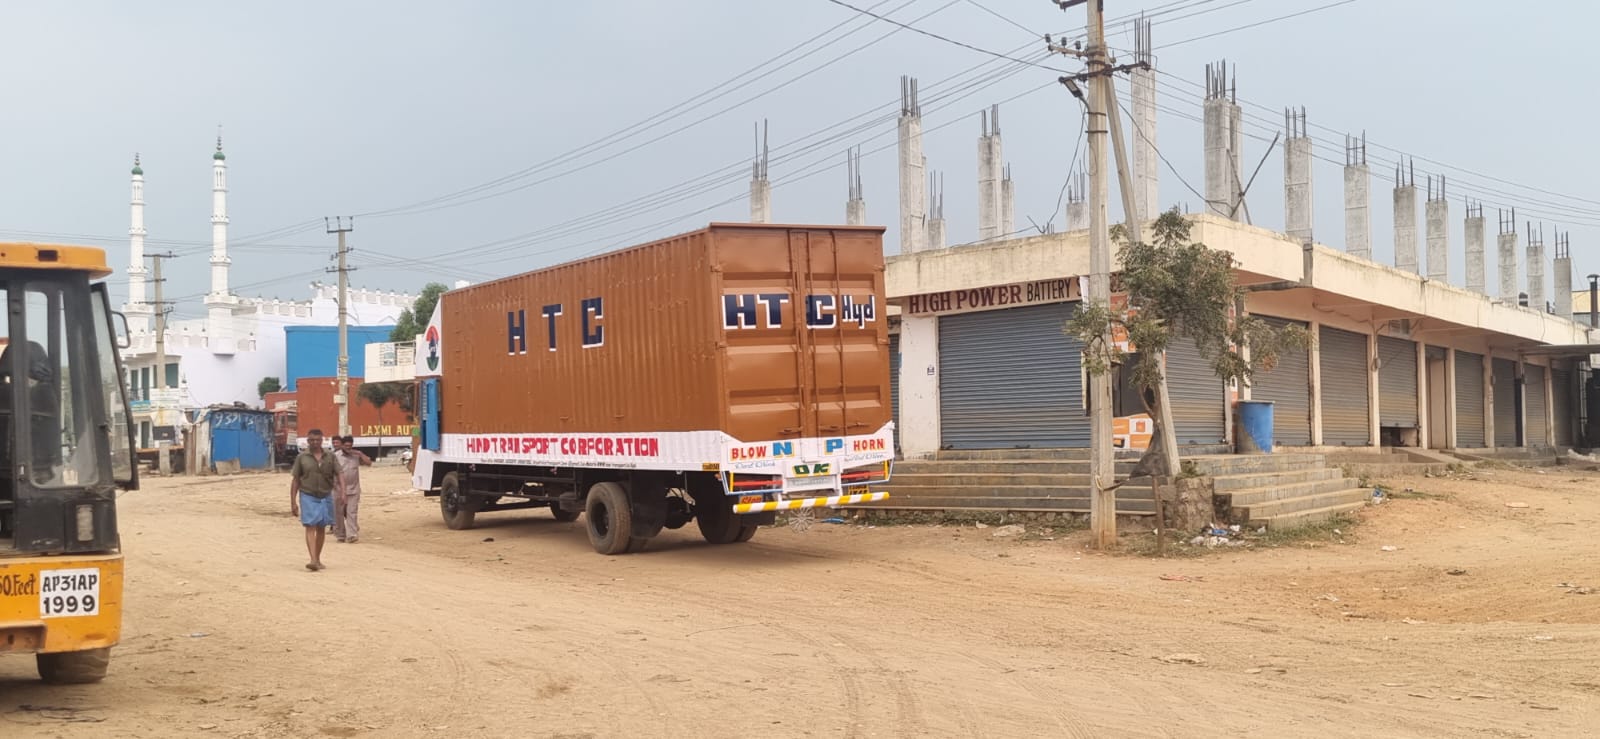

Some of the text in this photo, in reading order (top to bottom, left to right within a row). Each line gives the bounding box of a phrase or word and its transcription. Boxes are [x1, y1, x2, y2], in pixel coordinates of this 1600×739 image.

[908, 291, 952, 314] HIGH
[955, 284, 1022, 310] POWER
[1026, 278, 1072, 302] BATTERY
[842, 294, 876, 329] Hyd
[360, 424, 392, 437] LAXMI
[730, 438, 885, 460] BLOW N P HORN
[42, 574, 98, 592] AP31AP
[42, 594, 96, 614] 1999
